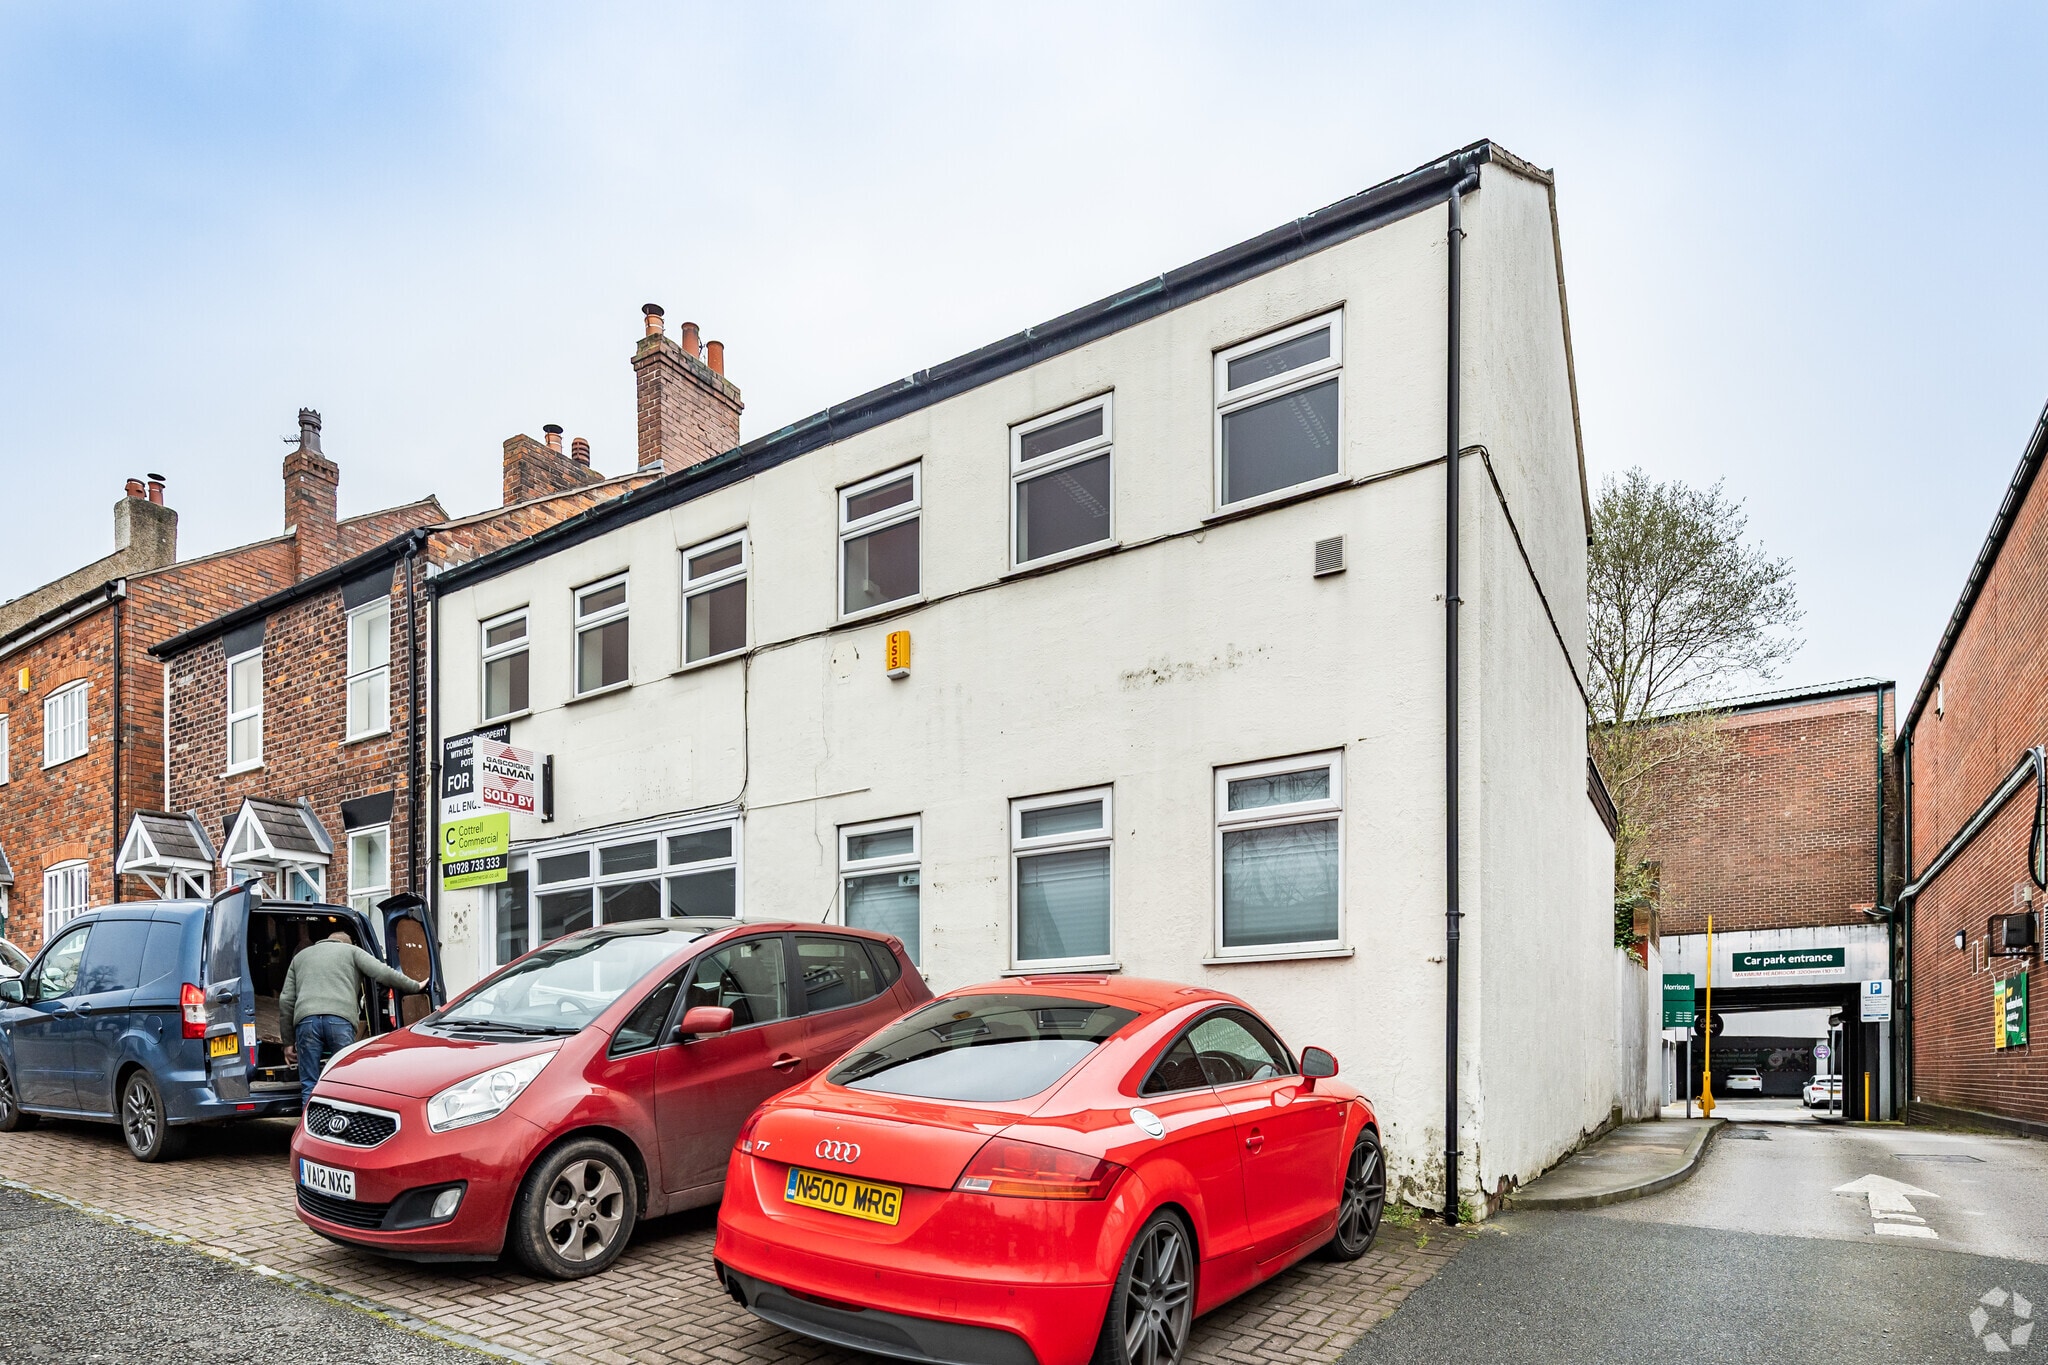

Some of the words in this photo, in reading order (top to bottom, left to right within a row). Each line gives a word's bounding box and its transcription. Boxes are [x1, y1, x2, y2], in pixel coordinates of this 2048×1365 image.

[446, 736, 473, 750] COMMERCI
[450, 749, 463, 759] WITH
[486, 756, 531, 771] GASCOIGNE
[482, 762, 534, 781] HALMAN
[447, 772, 470, 792] FOR
[484, 788, 515, 804] SOLD
[518, 794, 533, 808] BY
[448, 803, 461, 815] ALL
[458, 822, 484, 836] Cottrell
[458, 832, 499, 849] Commercial
[448, 861, 470, 876] 01928
[470, 858, 485, 872] 733
[485, 856, 500, 869] 333
[1743, 956, 1761, 966] Car
[1763, 953, 1786, 967] park
[1787, 953, 1833, 964] entrance
[1872, 983, 1881, 994] P
[332, 1118, 344, 1129] KIA
[756, 1140, 770, 1151] TT
[306, 1163, 326, 1189] VA12
[328, 1170, 352, 1195] NXG
[796, 1173, 848, 1207] N500
[853, 1185, 897, 1218] MRG
